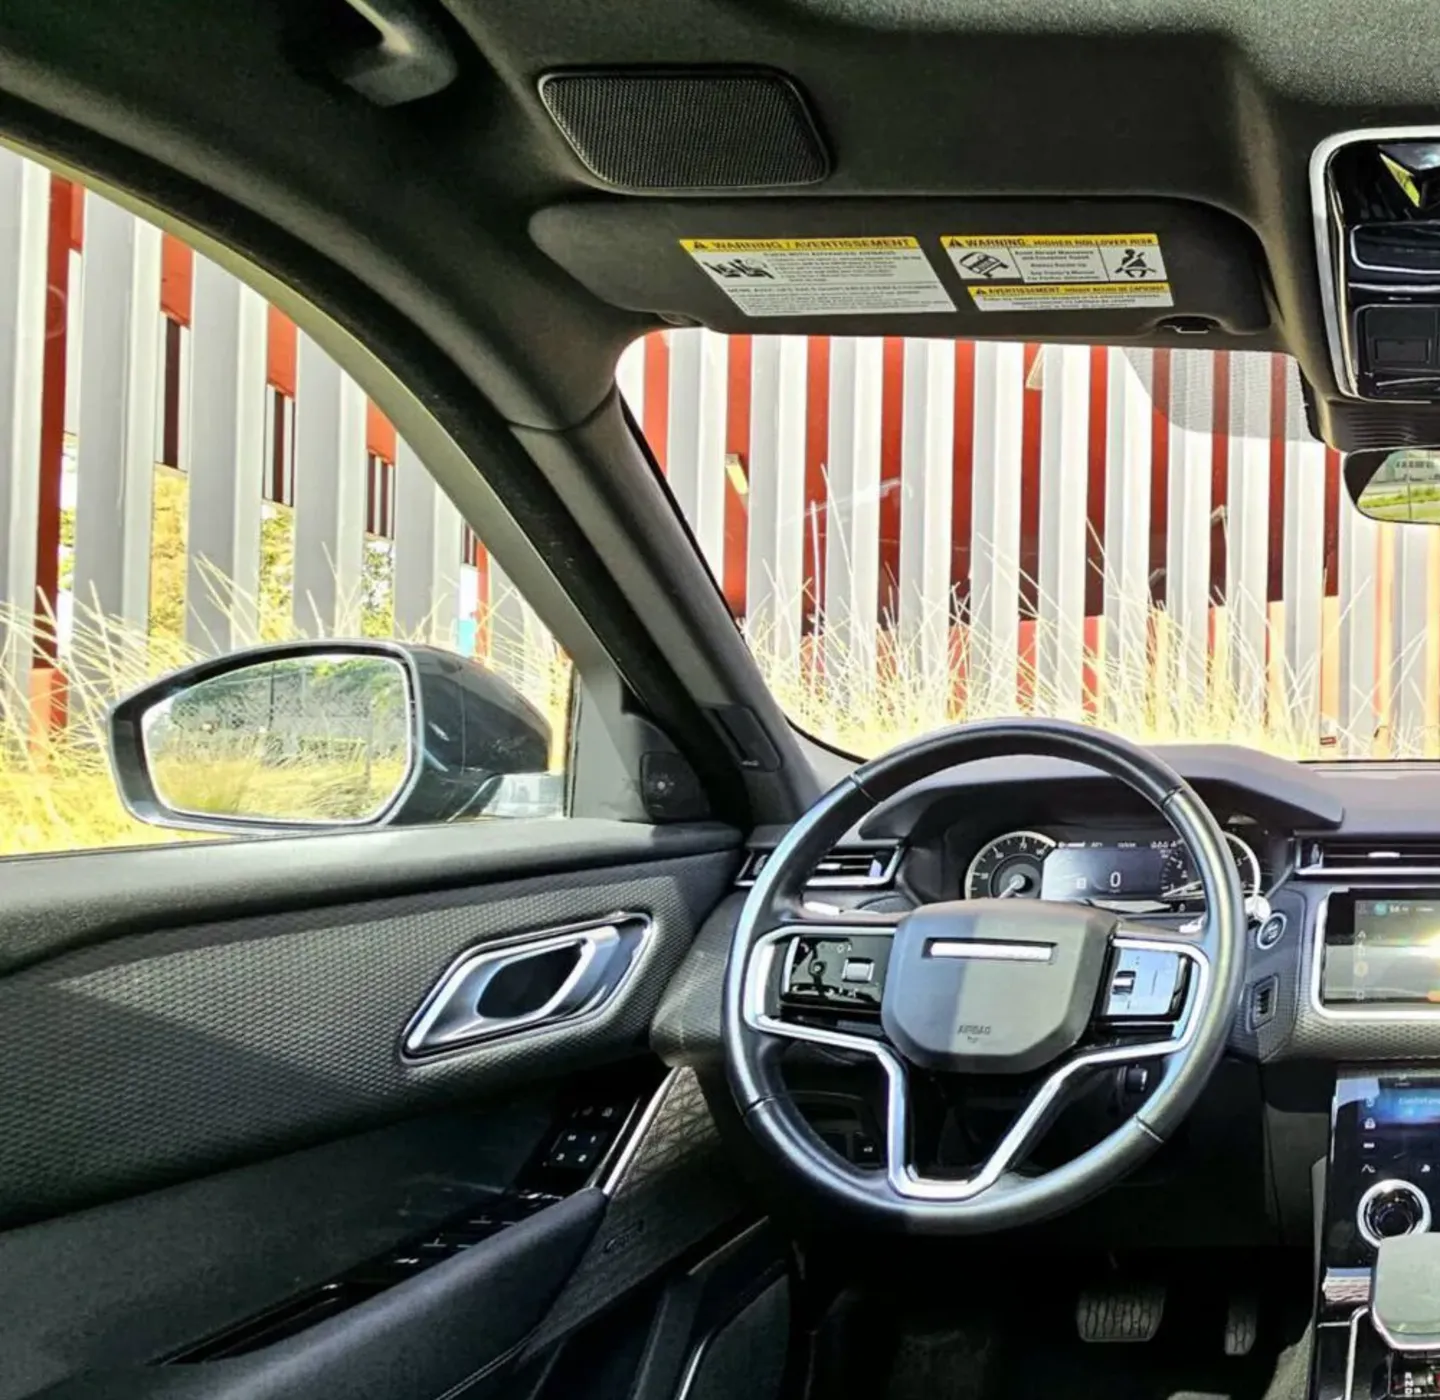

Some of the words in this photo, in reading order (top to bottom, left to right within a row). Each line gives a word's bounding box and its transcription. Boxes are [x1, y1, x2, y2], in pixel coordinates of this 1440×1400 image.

[711, 241, 783, 250] WARNING
[794, 239, 911, 249] AVERTISSEMENT
[1110, 871, 1121, 887] 0
